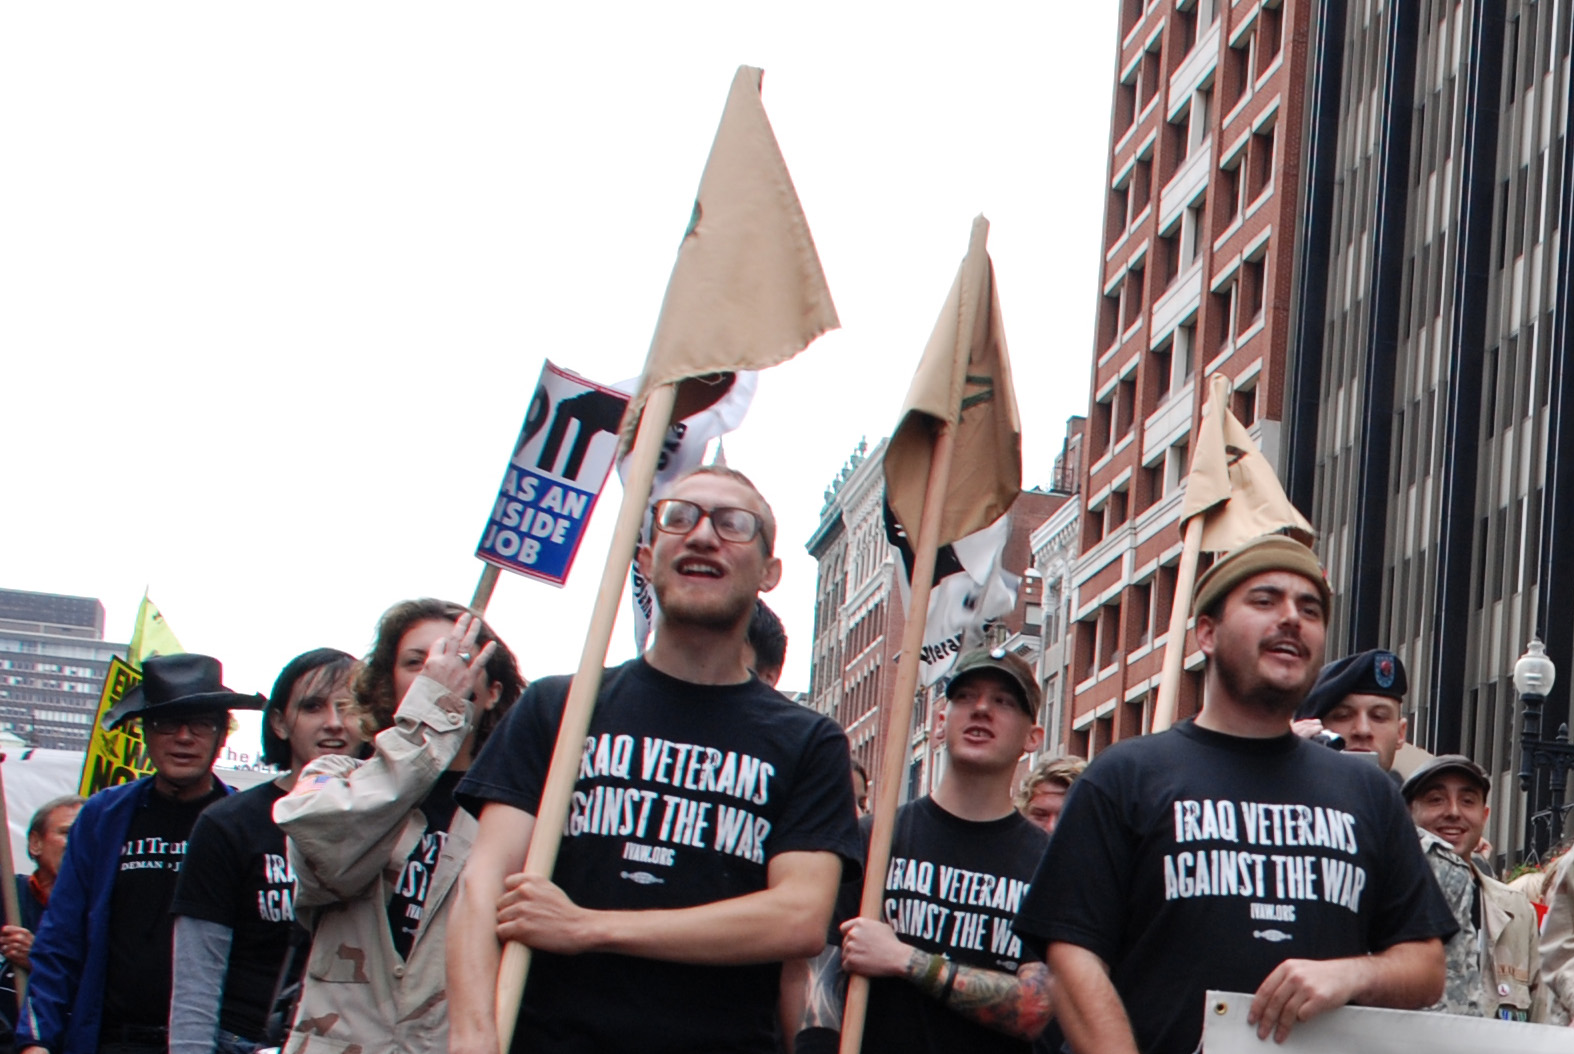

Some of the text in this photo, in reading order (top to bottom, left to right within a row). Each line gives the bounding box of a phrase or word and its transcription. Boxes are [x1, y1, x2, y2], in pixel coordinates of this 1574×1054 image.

[540, 485, 589, 520] AN
[483, 524, 541, 565] JOB
[641, 736, 775, 806] VETERANS
[659, 794, 712, 848] THE
[714, 804, 772, 865] WAR
[1173, 799, 1358, 855] IRAQ VETERANS
[885, 856, 935, 897] IRAQ
[1163, 850, 1366, 914] AGAINST THE WAR
[885, 898, 1022, 959] GAINST THE WA
[1250, 902, 1296, 922] IVAW.ORG
